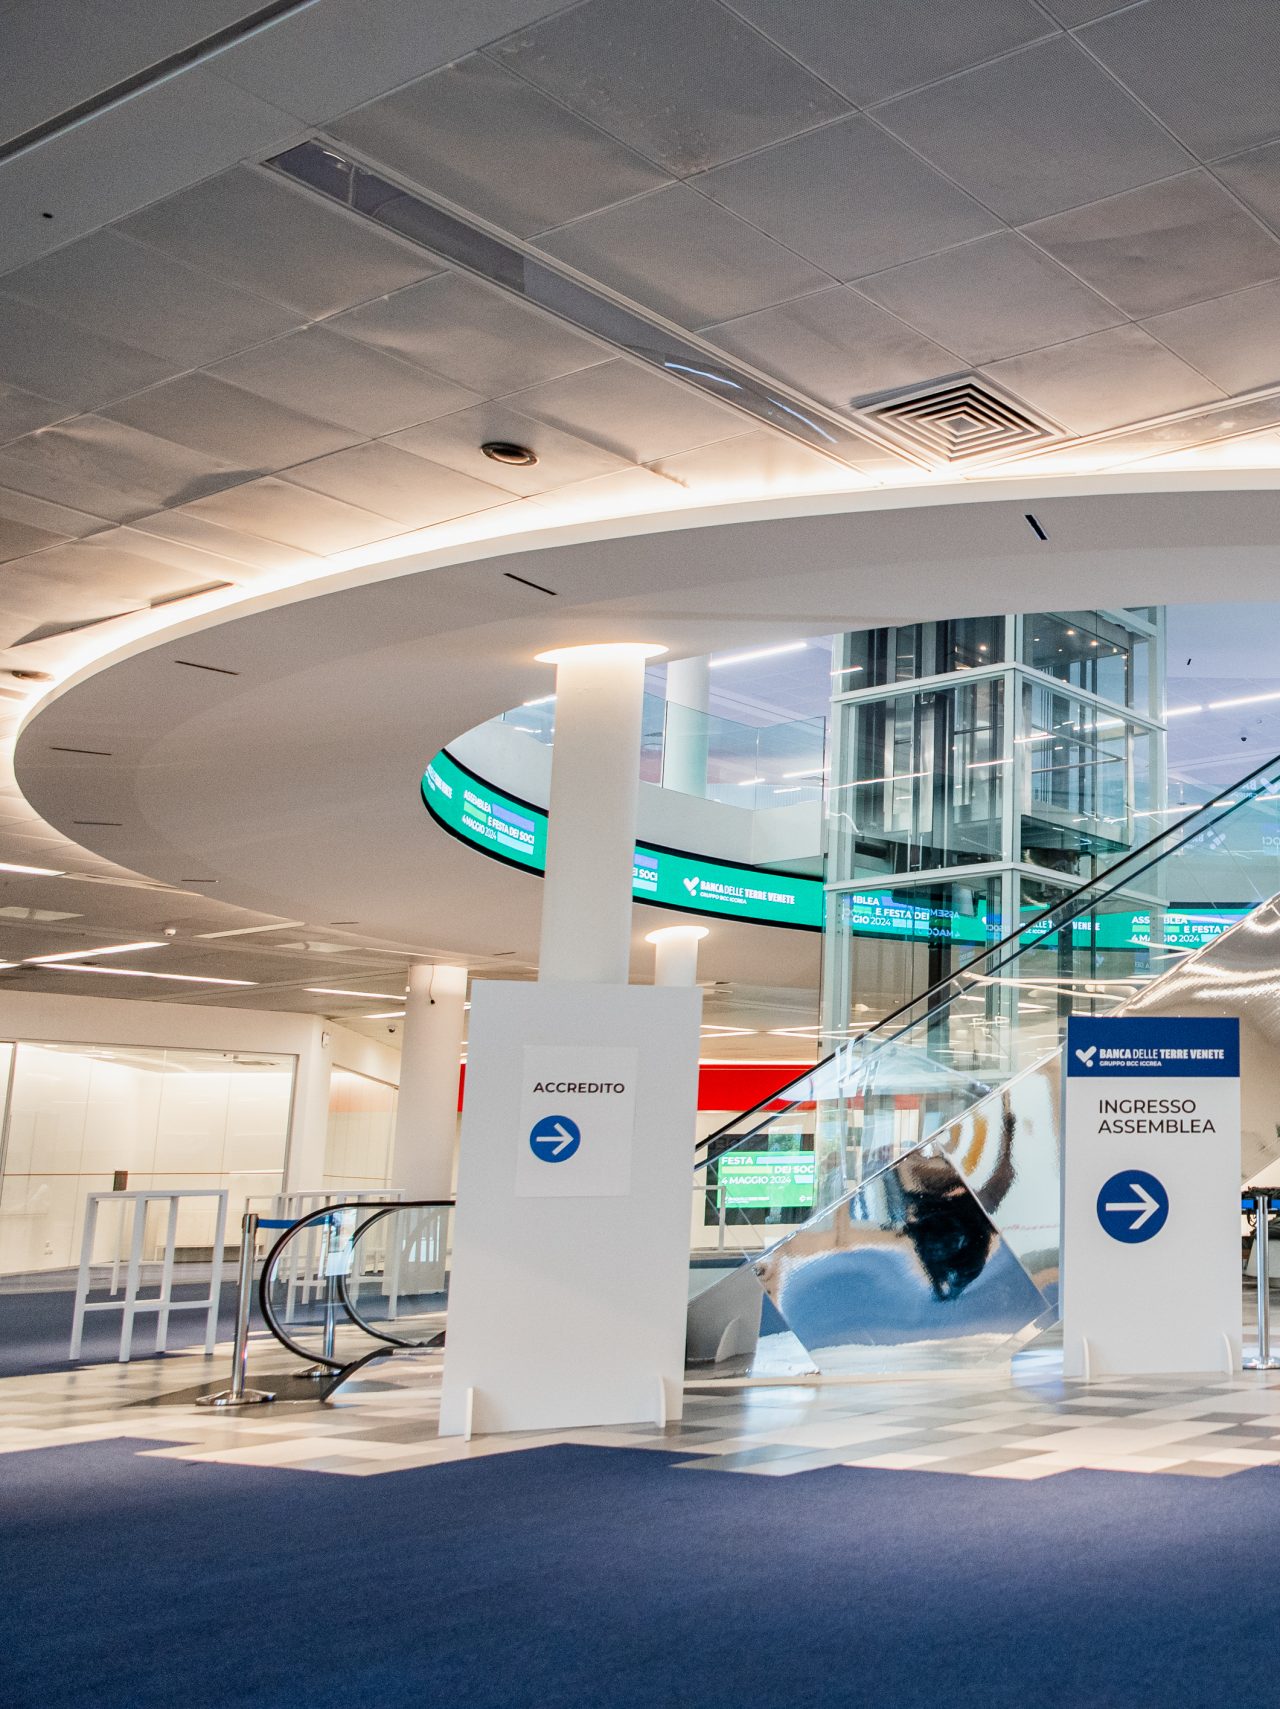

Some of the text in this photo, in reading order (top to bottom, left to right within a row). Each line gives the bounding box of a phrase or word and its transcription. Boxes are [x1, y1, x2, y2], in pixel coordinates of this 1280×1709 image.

[639, 869, 658, 881] SOCI
[700, 880, 795, 904] BANCA DELLE TERRE VENETE
[884, 908, 912, 919] FESTA
[914, 911, 929, 920] DEI
[870, 917, 891, 927] 2024
[1132, 916, 1188, 924] ASSBLEA
[1072, 921, 1100, 930] VENEE
[1179, 934, 1200, 942] 2024
[1100, 1049, 1225, 1060] BANCA DELLE TERRE VENETE
[533, 1082, 625, 1094] ACCREDITO
[1099, 1099, 1196, 1114] INGRESSO
[1098, 1119, 1216, 1134] ASSEMBLEA
[722, 1157, 753, 1165] FESTA
[774, 1165, 815, 1174] DEI SOC
[722, 1176, 791, 1185] 4 MAGGIO 2024
